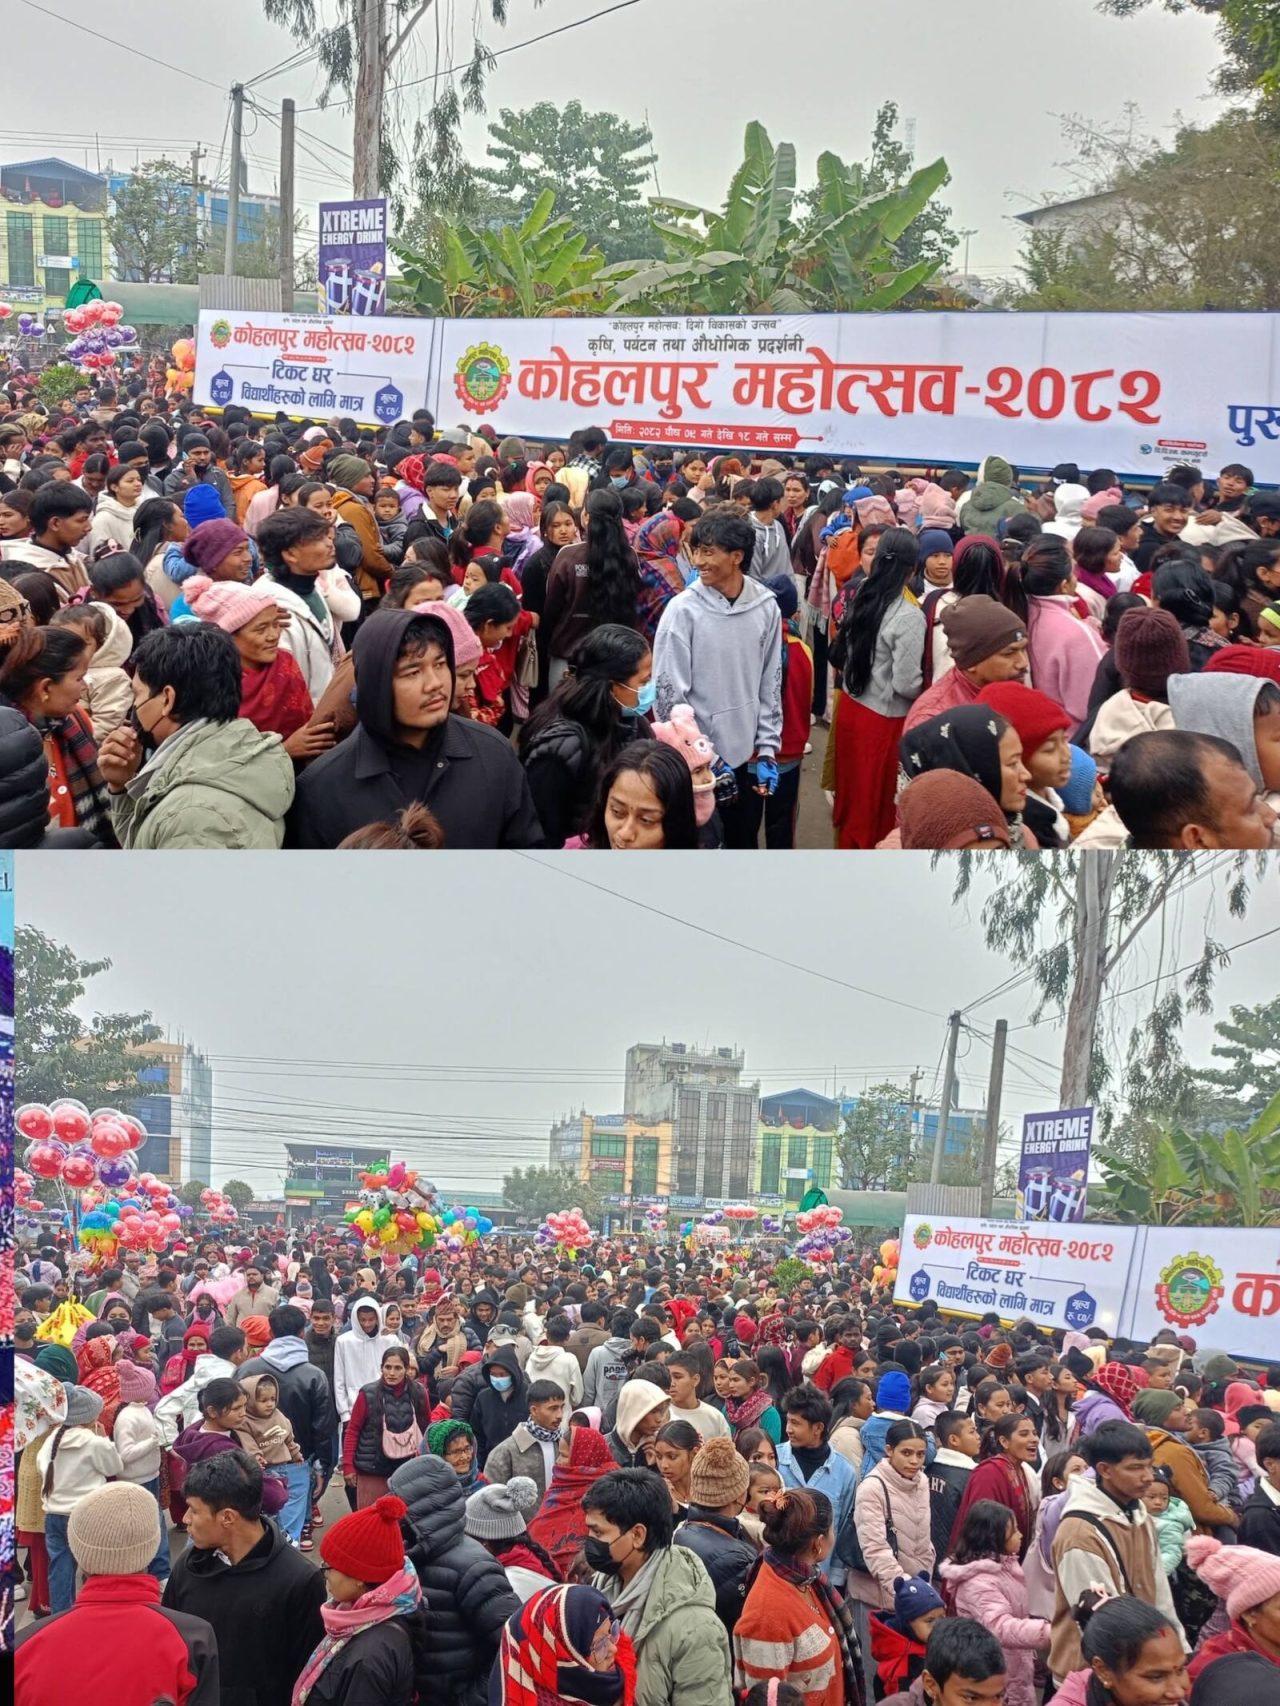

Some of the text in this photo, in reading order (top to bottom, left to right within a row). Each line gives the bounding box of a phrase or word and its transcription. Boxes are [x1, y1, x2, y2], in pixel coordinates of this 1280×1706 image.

[322, 208, 384, 232] XTREME
[322, 230, 384, 246] ENERGY DRINK
[233, 321, 300, 352] कोहलपुर
[623, 334, 658, 352] पर्यटन
[662, 337, 686, 352] तथा
[758, 333, 805, 353] प्रदर्शनी
[272, 359, 334, 385] टिकट घर
[519, 346, 719, 419] कोहलपुर
[308, 388, 336, 408] लागि
[339, 395, 364, 412] मात्र
[1025, 1115, 1090, 1142] XTREME
[1024, 1138, 1088, 1155] ENERGY DRINK
[934, 1226, 996, 1254] कोहलपुर
[966, 1261, 1001, 1284] टिकट
[1004, 1270, 1026, 1287] घर
[999, 1291, 1027, 1311] लागि
[1029, 1298, 1056, 1316] मात्र
